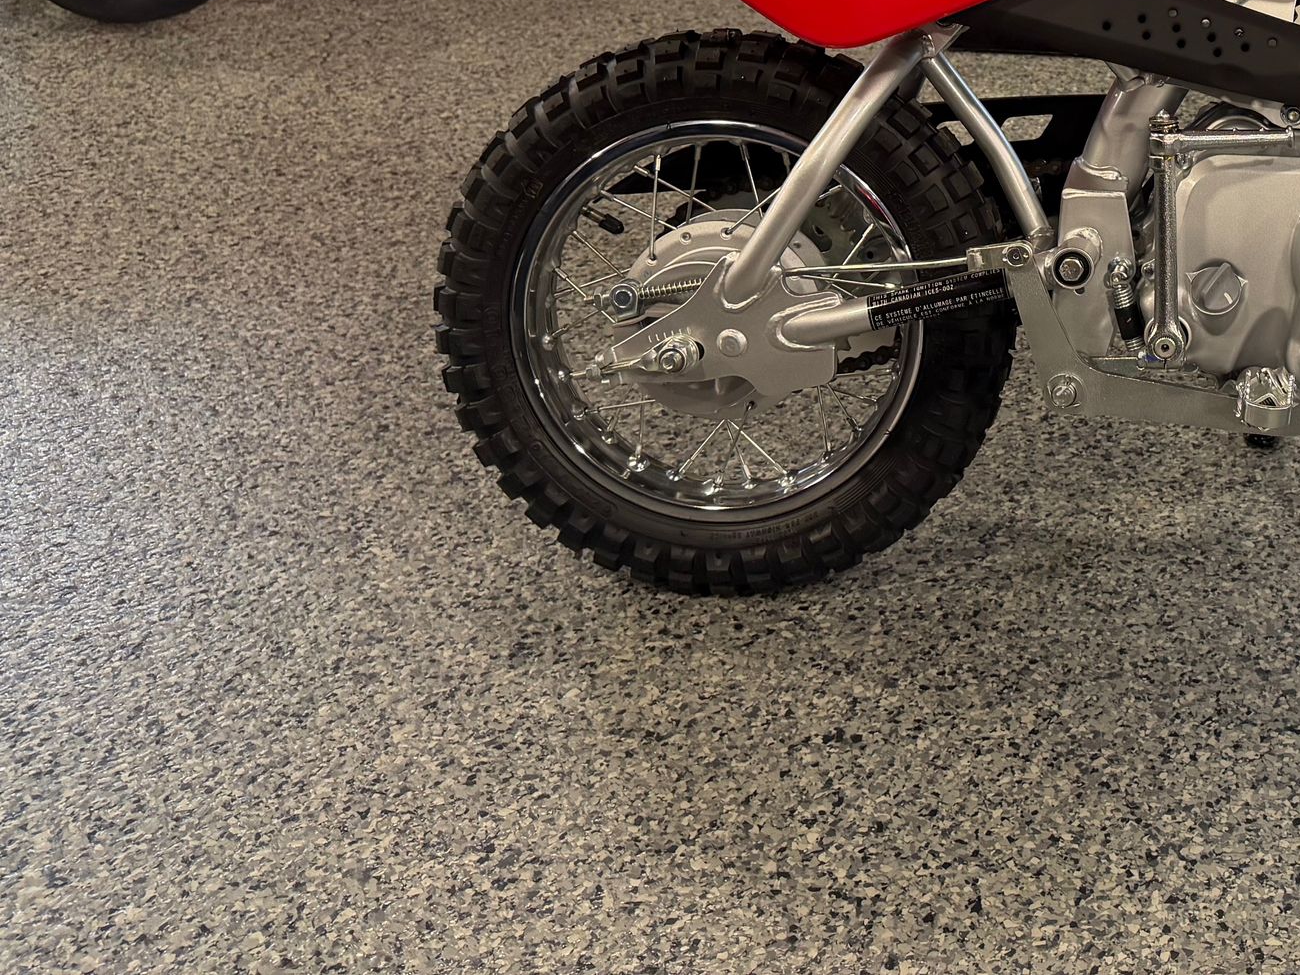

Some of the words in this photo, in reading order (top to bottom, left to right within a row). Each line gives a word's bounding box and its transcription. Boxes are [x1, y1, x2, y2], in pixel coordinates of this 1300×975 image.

[890, 290, 921, 304] CANADIAN
[874, 314, 883, 322] CE
[956, 295, 968, 304] PAR
